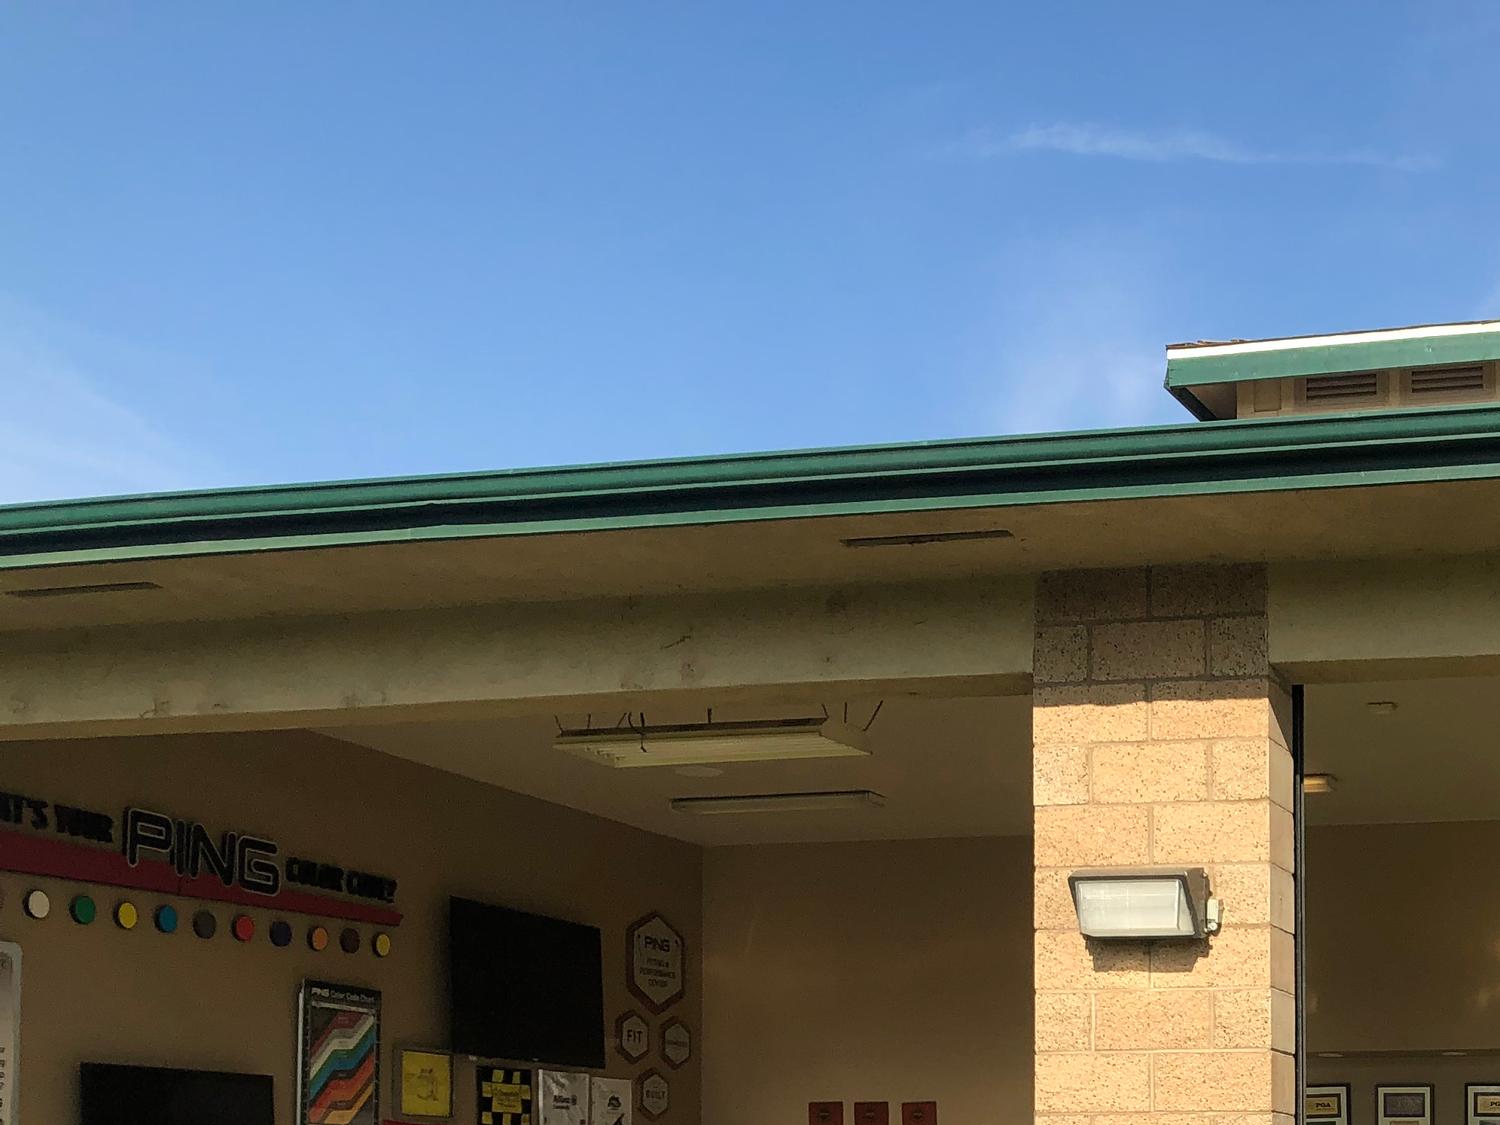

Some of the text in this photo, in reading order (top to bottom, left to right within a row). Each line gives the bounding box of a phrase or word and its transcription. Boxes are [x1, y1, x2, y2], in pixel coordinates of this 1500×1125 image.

[125, 808, 282, 898] PING
[626, 1029, 643, 1044] FIT
[1315, 1101, 1331, 1109] PGA
